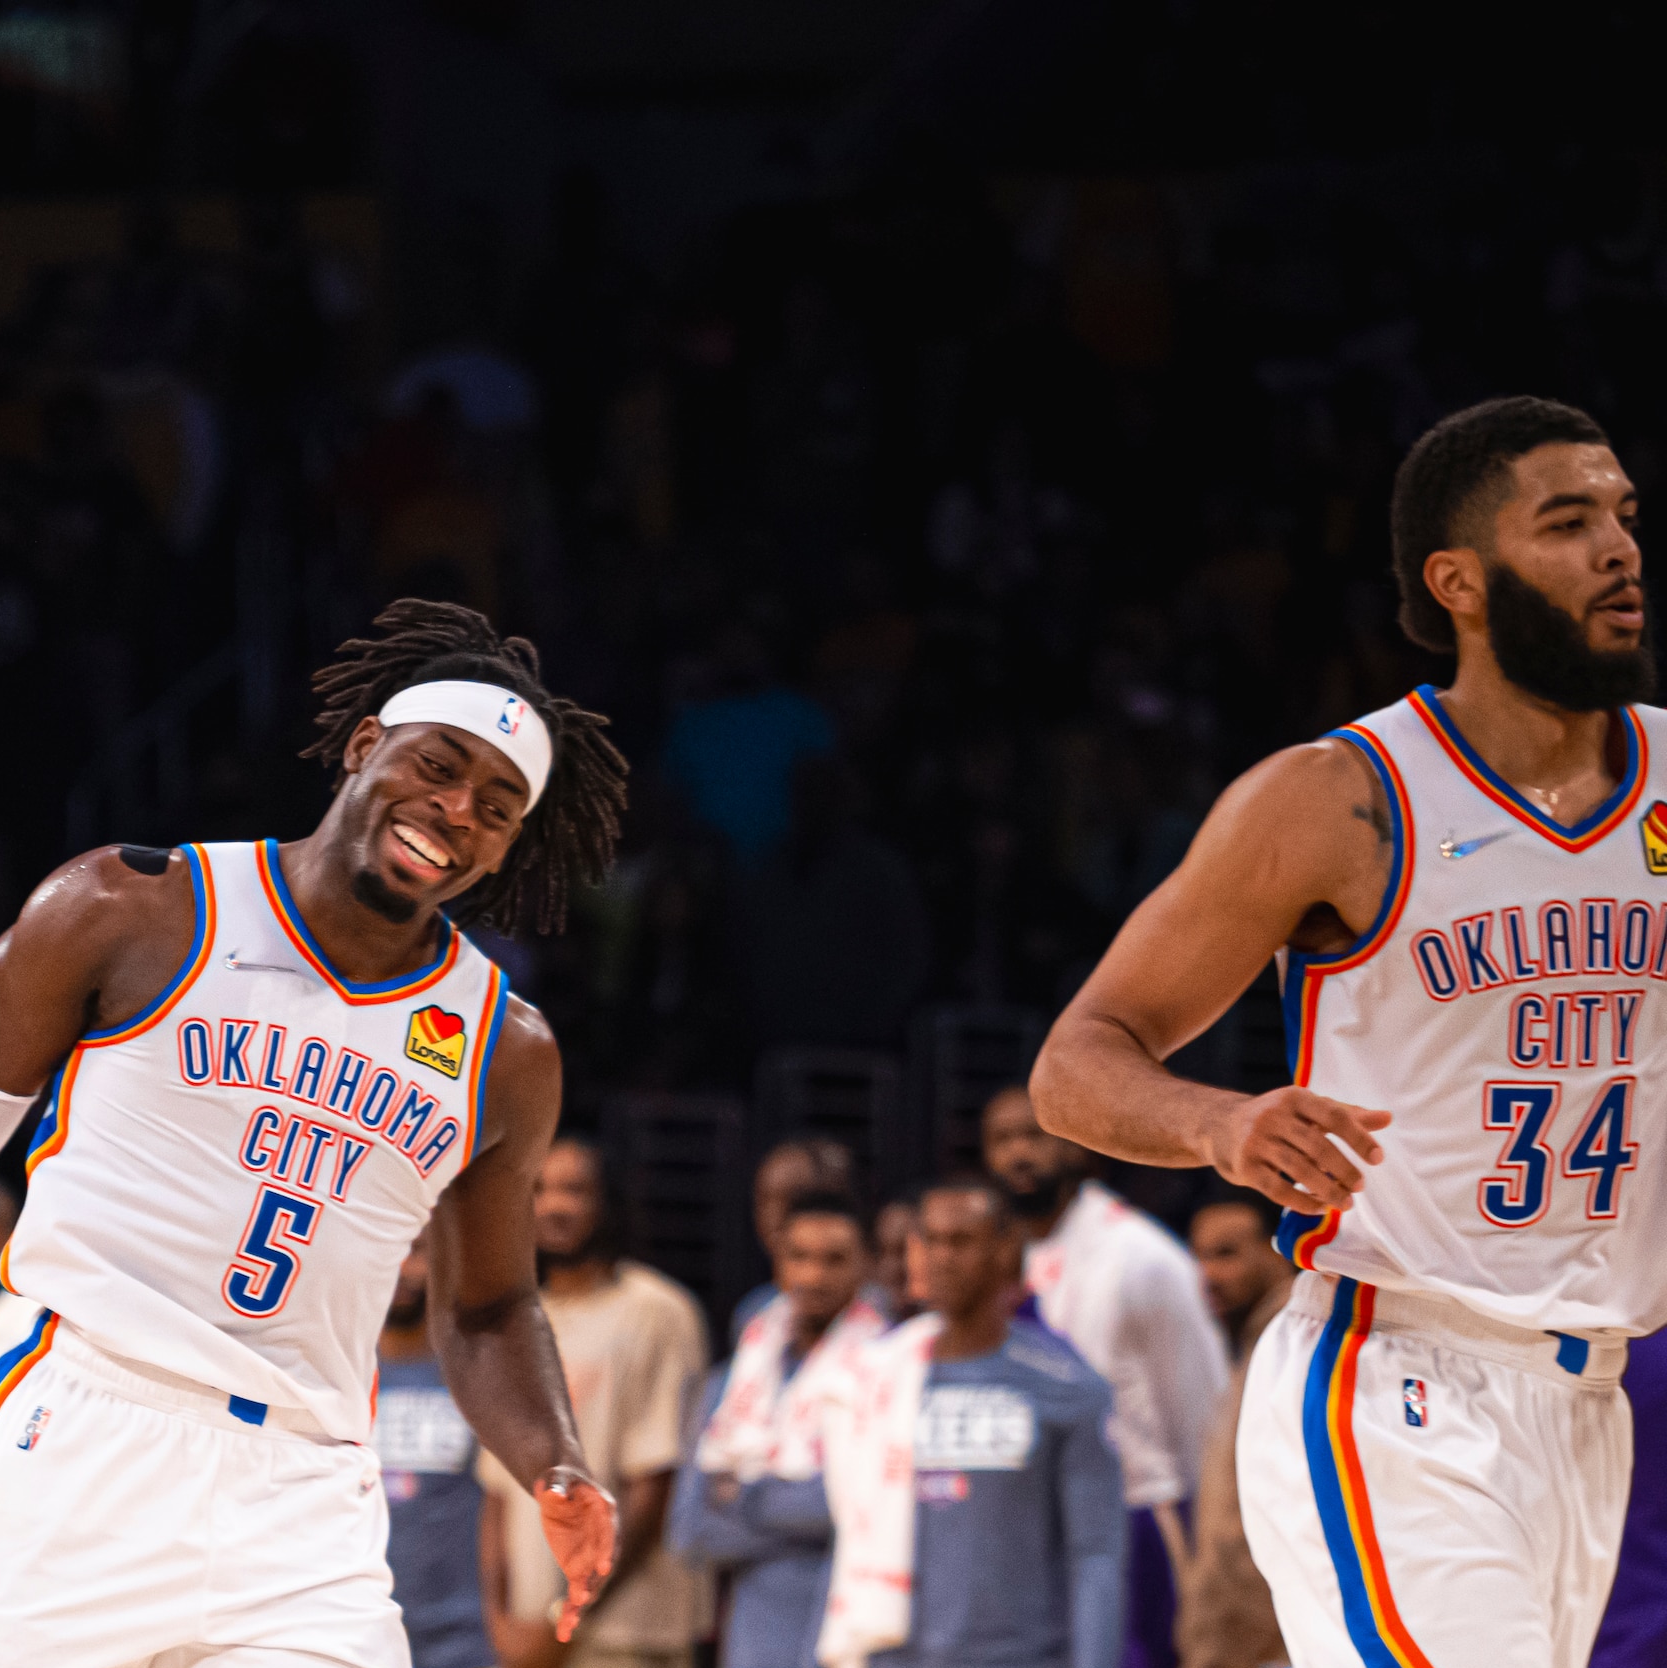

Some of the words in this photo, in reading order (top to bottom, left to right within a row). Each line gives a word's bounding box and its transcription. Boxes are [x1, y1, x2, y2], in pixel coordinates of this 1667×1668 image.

[1410, 896, 1667, 1003] OKLAHO
[1508, 989, 1646, 1068] CITY
[177, 1017, 461, 1179] OKLAHOMA
[238, 1105, 374, 1202] CITY
[1478, 1076, 1640, 1228] 34
[221, 1182, 324, 1319] 5
